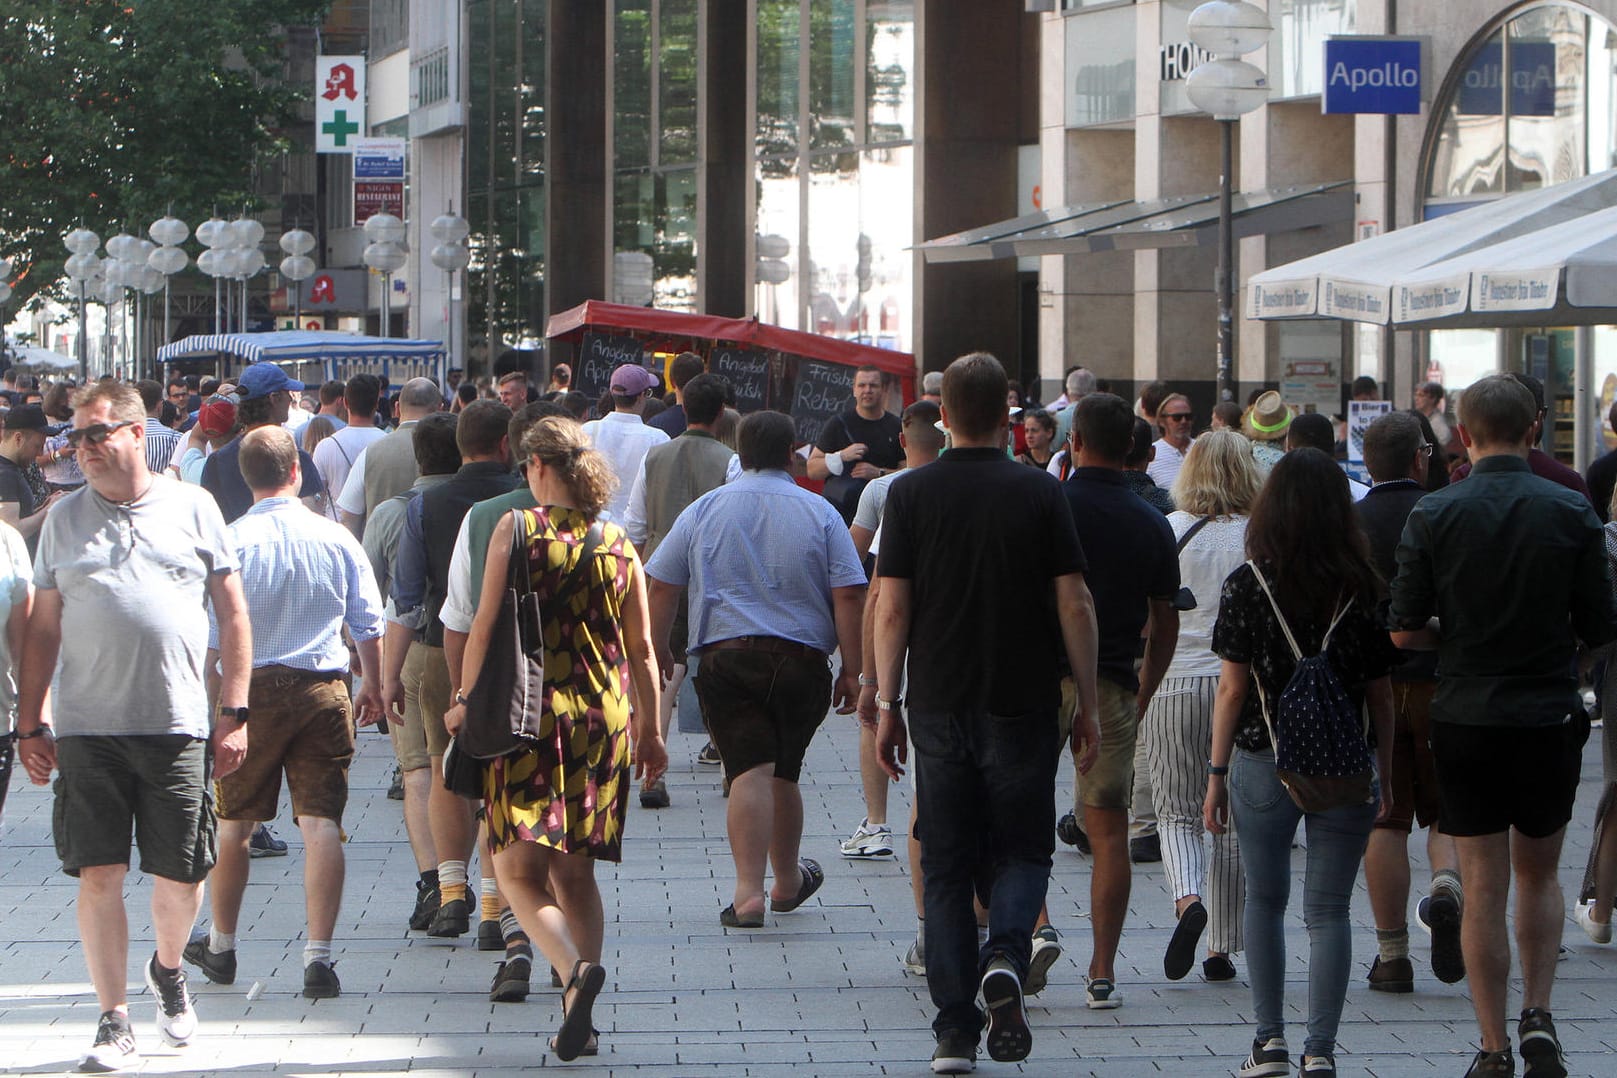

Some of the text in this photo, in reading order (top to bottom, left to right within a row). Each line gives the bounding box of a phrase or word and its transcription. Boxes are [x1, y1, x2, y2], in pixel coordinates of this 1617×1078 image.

[1329, 61, 1419, 92] Apollo
[584, 359, 613, 385] Apri
[1361, 403, 1379, 411] Bier
[1359, 416, 1368, 424] to
